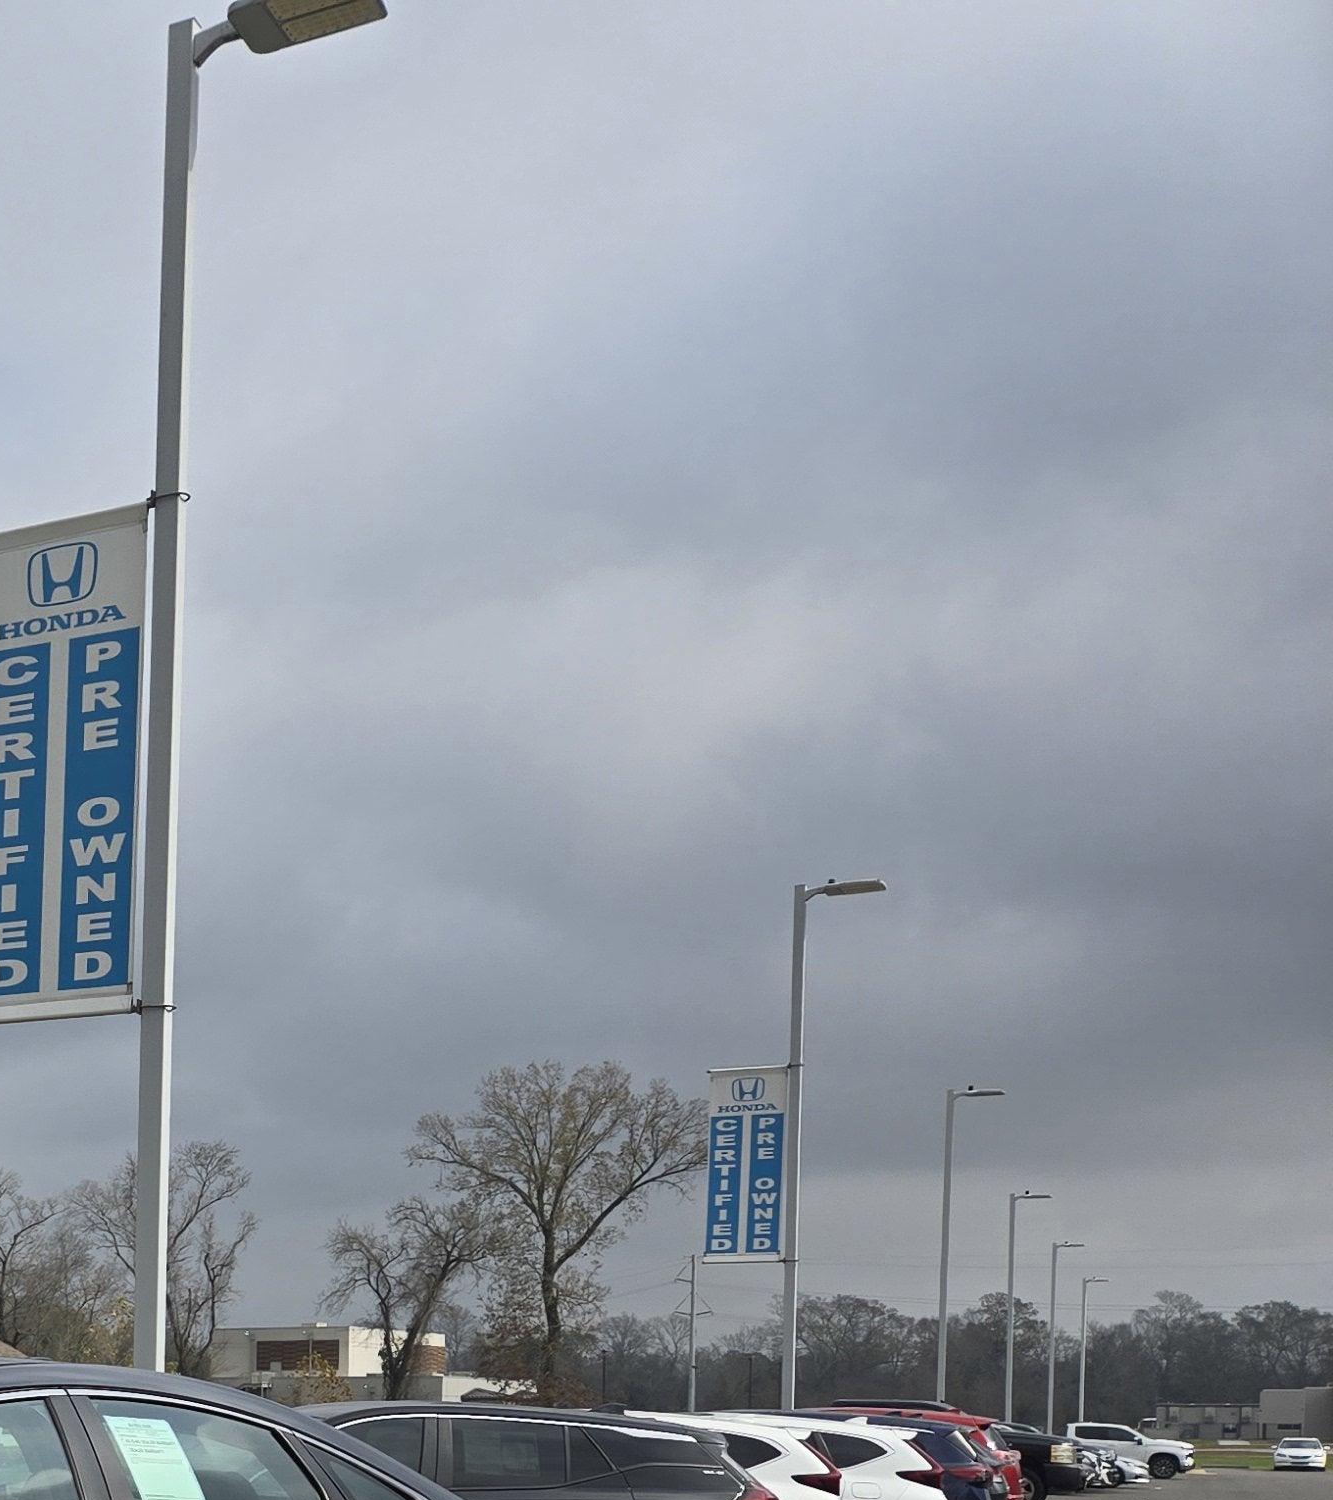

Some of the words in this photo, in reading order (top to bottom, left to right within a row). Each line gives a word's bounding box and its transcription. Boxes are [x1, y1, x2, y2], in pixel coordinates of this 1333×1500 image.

[81, 640, 123, 752] PRE
[69, 795, 127, 982] OWNED
[717, 1103, 777, 1114] HONDA
[757, 1117, 776, 1161] PRE
[710, 1119, 738, 1251] CERTIFIED
[751, 1177, 778, 1251] OWNED
